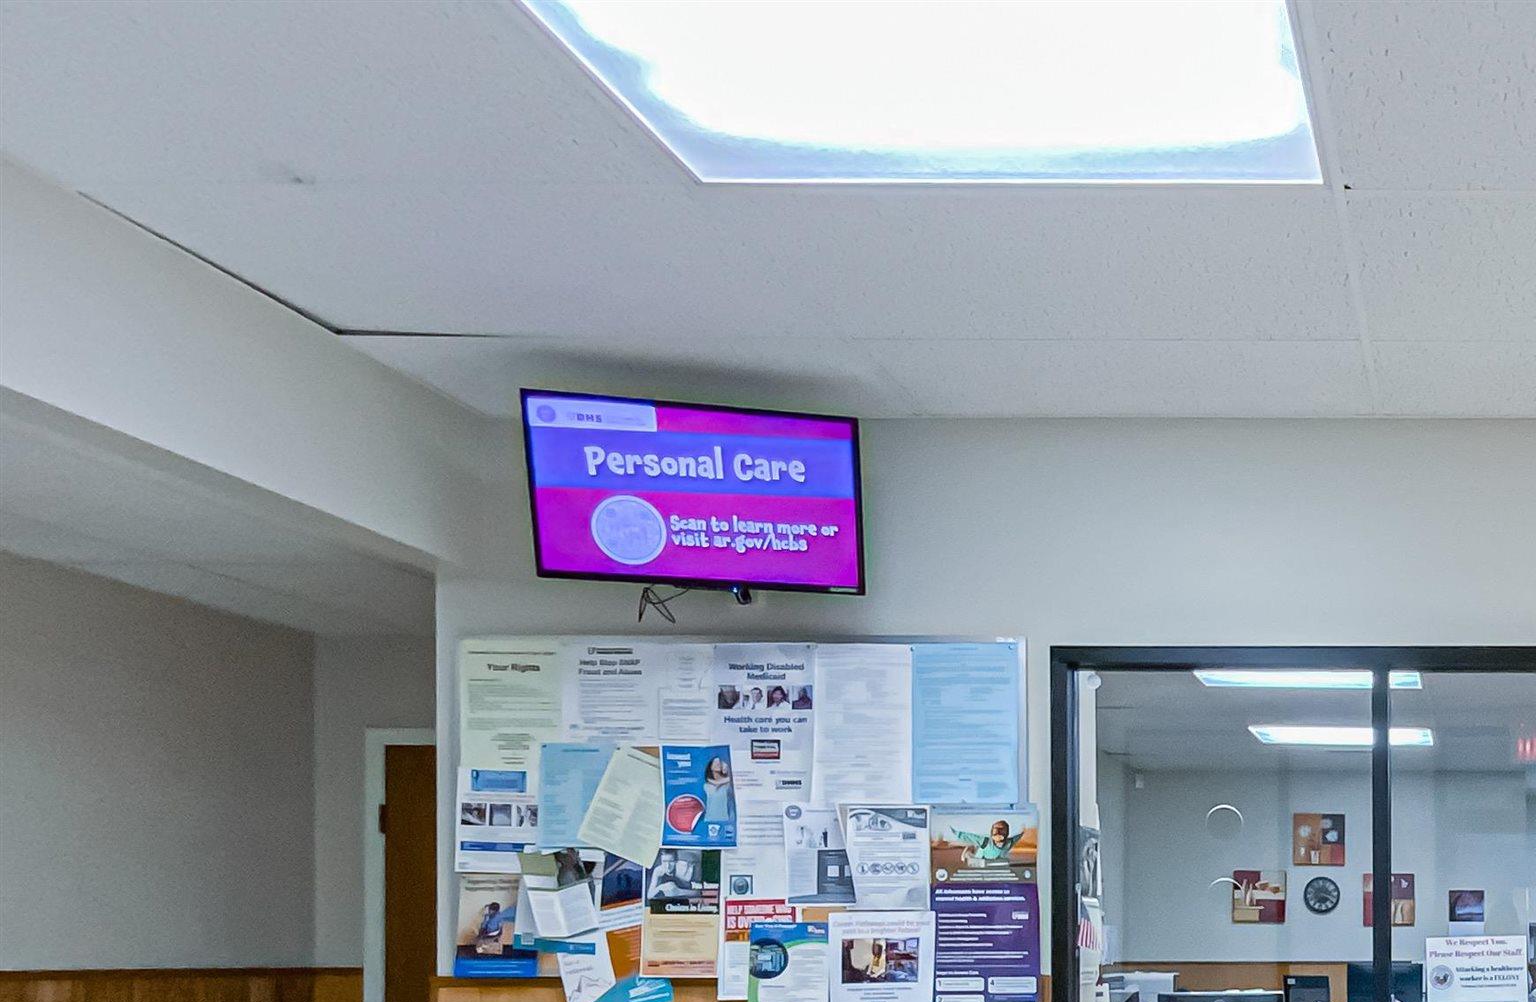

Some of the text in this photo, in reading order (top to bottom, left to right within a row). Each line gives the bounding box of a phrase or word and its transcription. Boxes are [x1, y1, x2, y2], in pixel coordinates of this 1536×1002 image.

[583, 445, 806, 483] Personal Care
[669, 514, 839, 537] Scan to learn more or
[671, 531, 808, 554] visit ar.gov/hcbs
[487, 663, 541, 673] Your Rights
[728, 663, 765, 671] Working
[723, 716, 753, 724] Health
[775, 717, 791, 725] you
[1459, 939, 1489, 947] Respect
[1455, 950, 1485, 959] Respect
